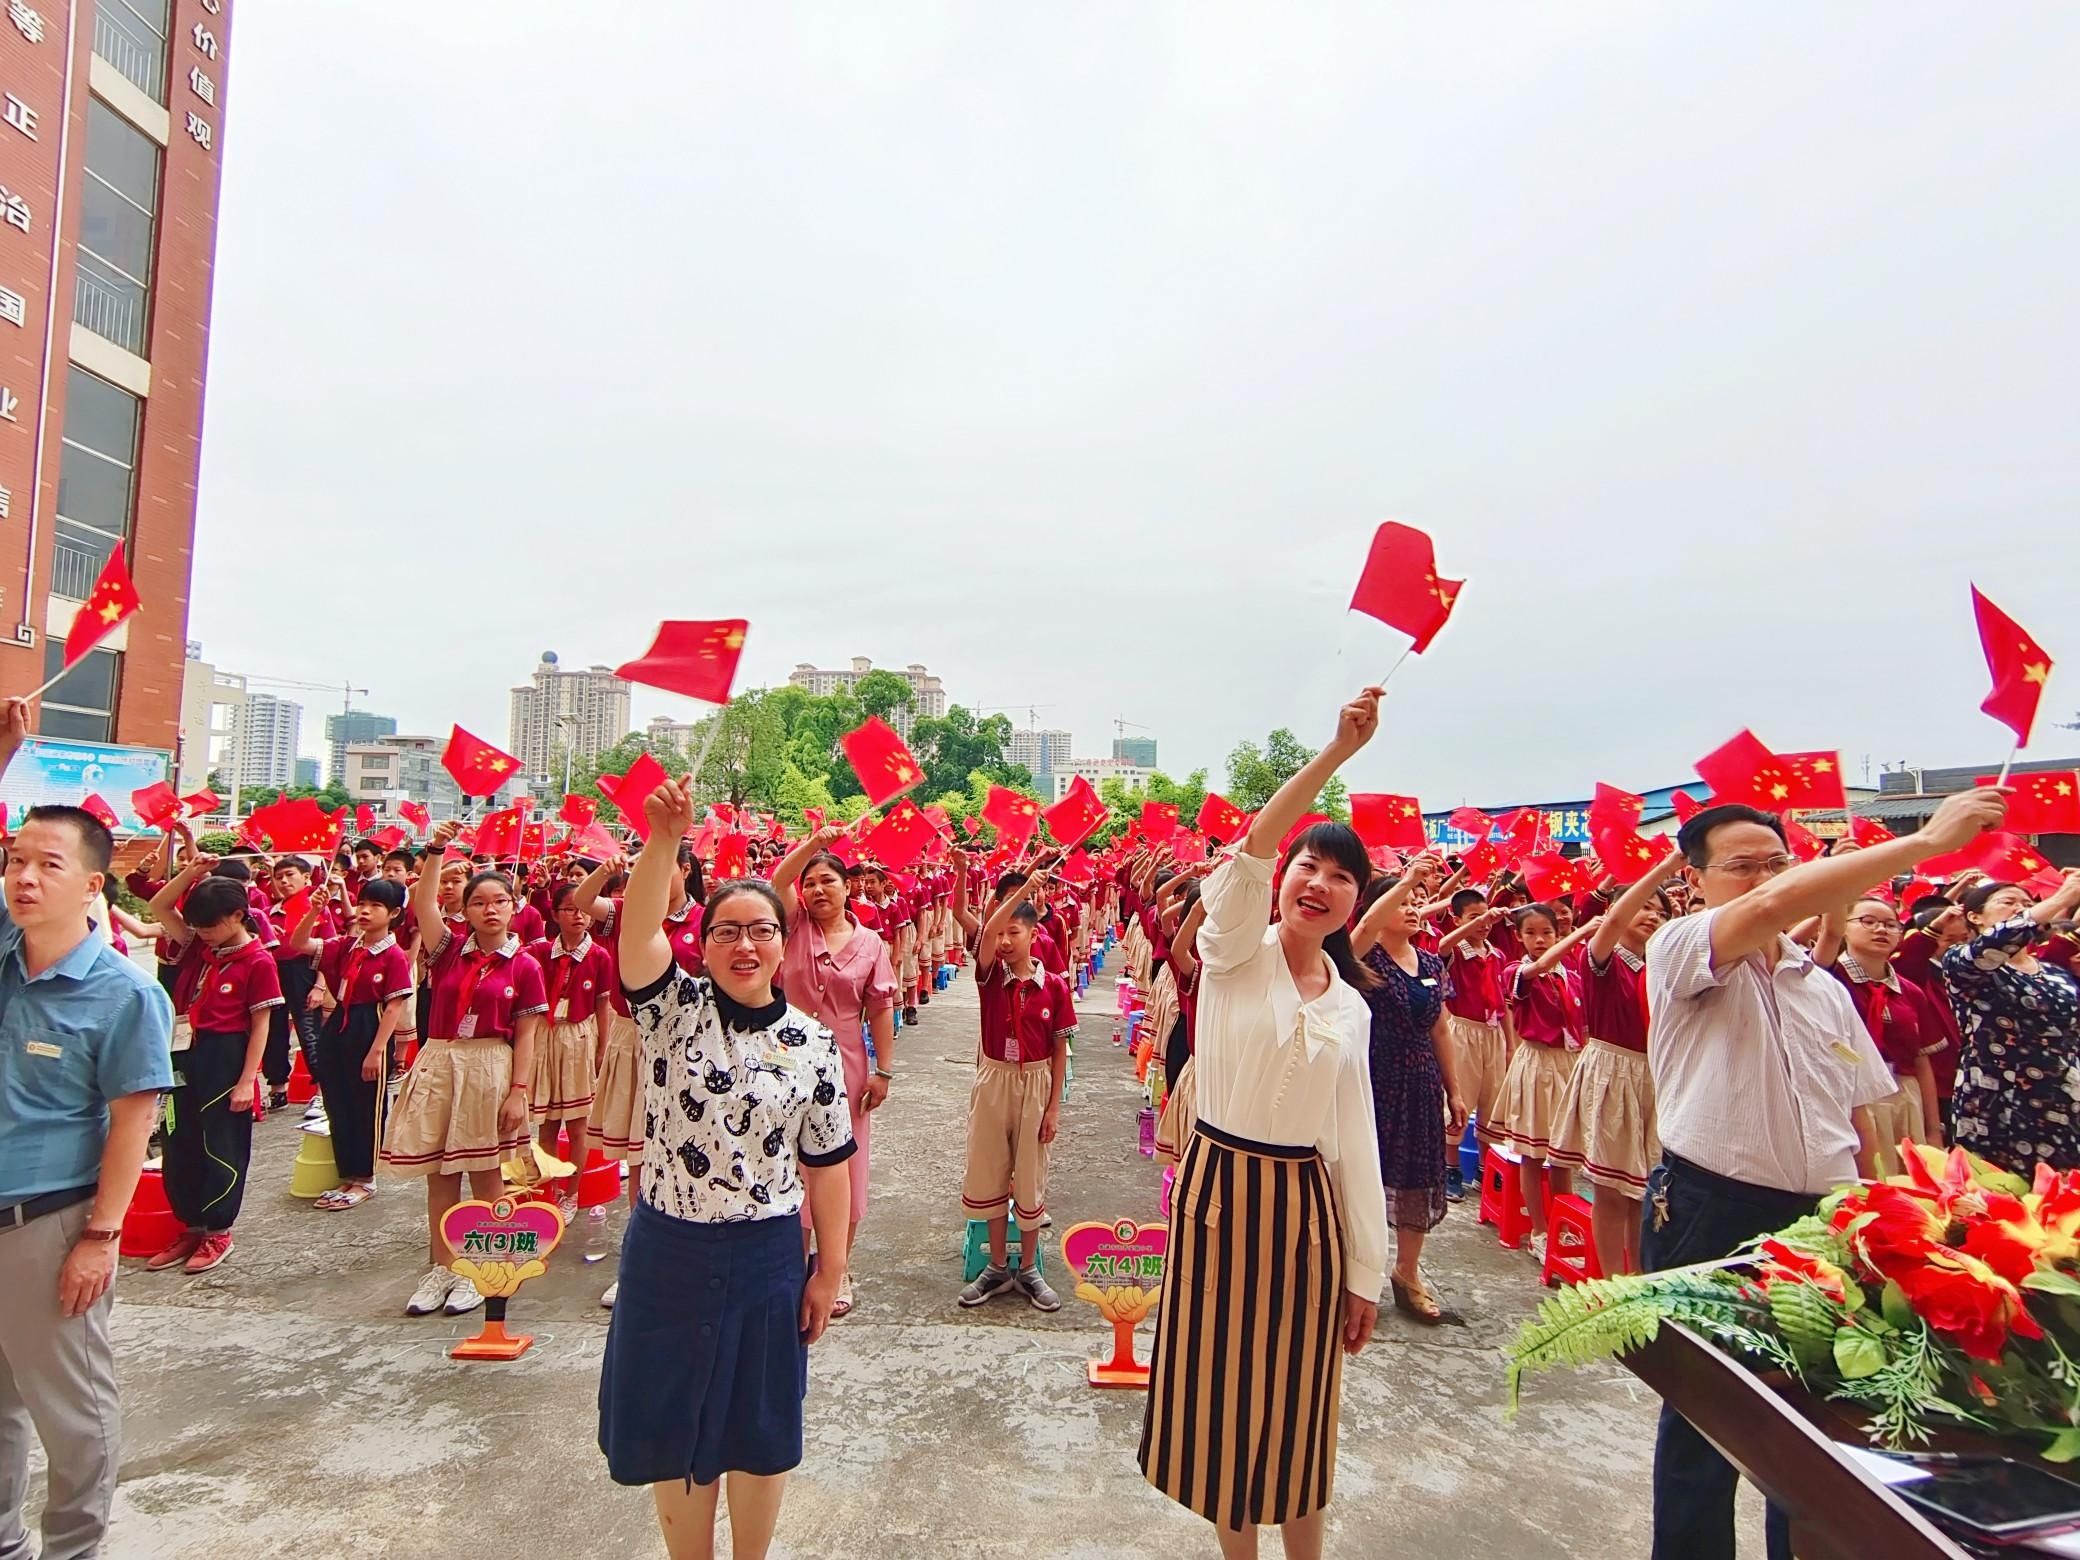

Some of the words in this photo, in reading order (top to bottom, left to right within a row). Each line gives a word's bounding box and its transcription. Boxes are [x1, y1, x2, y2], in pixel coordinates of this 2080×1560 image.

[6, 0, 46, 43] 等
[3, 92, 39, 142] 正
[0, 185, 33, 234] 治
[464, 1230, 538, 1254] 六(3)班
[1087, 1254, 1164, 1278] 六(4)班
